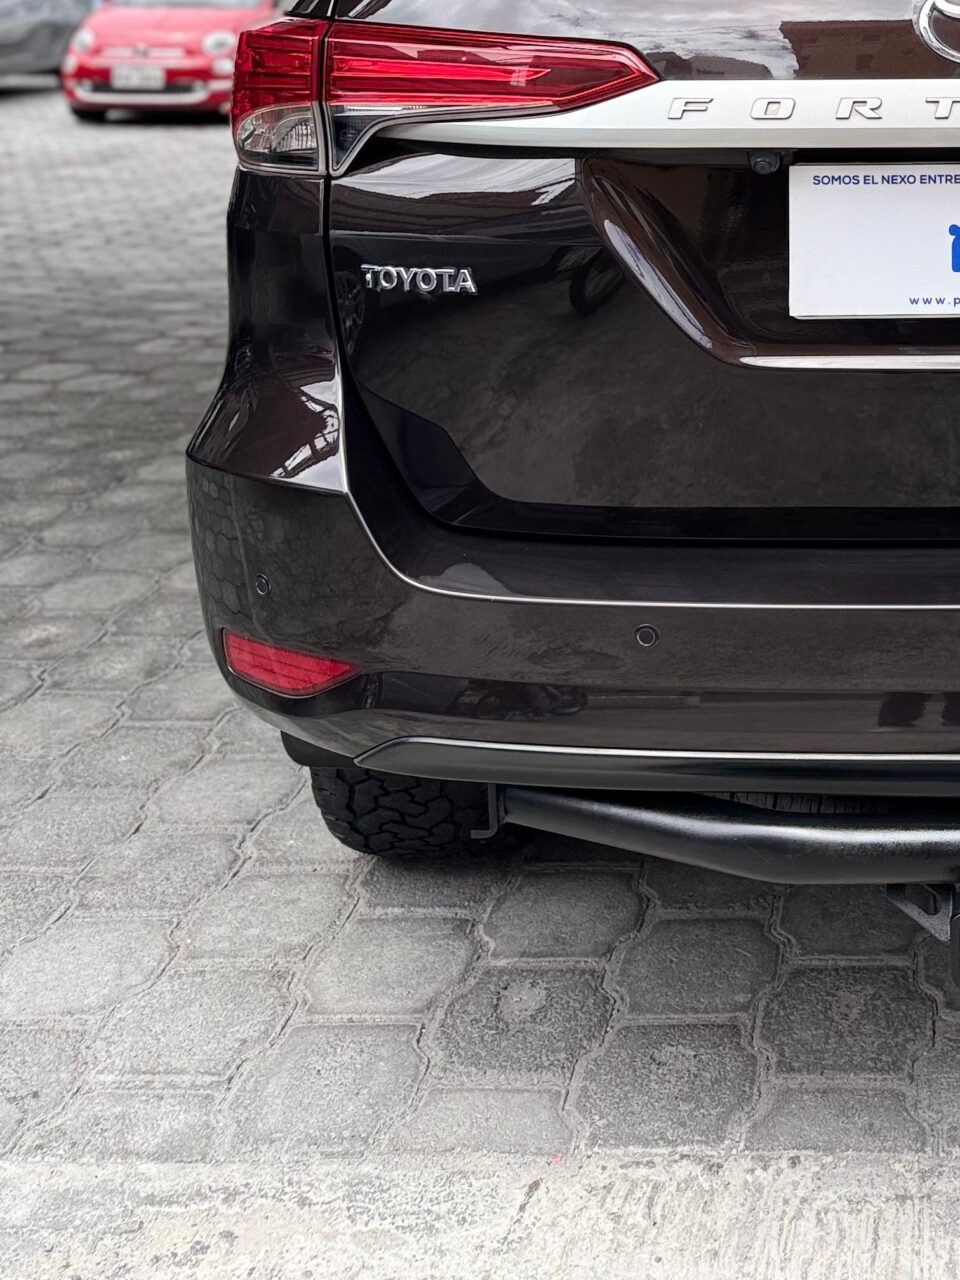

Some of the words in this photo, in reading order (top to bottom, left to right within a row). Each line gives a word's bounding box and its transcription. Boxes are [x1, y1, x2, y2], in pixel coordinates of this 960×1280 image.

[812, 174, 861, 186] SOMOS
[863, 174, 879, 186] EL
[881, 174, 917, 186] NEXO
[360, 264, 478, 295] TOYOTA
